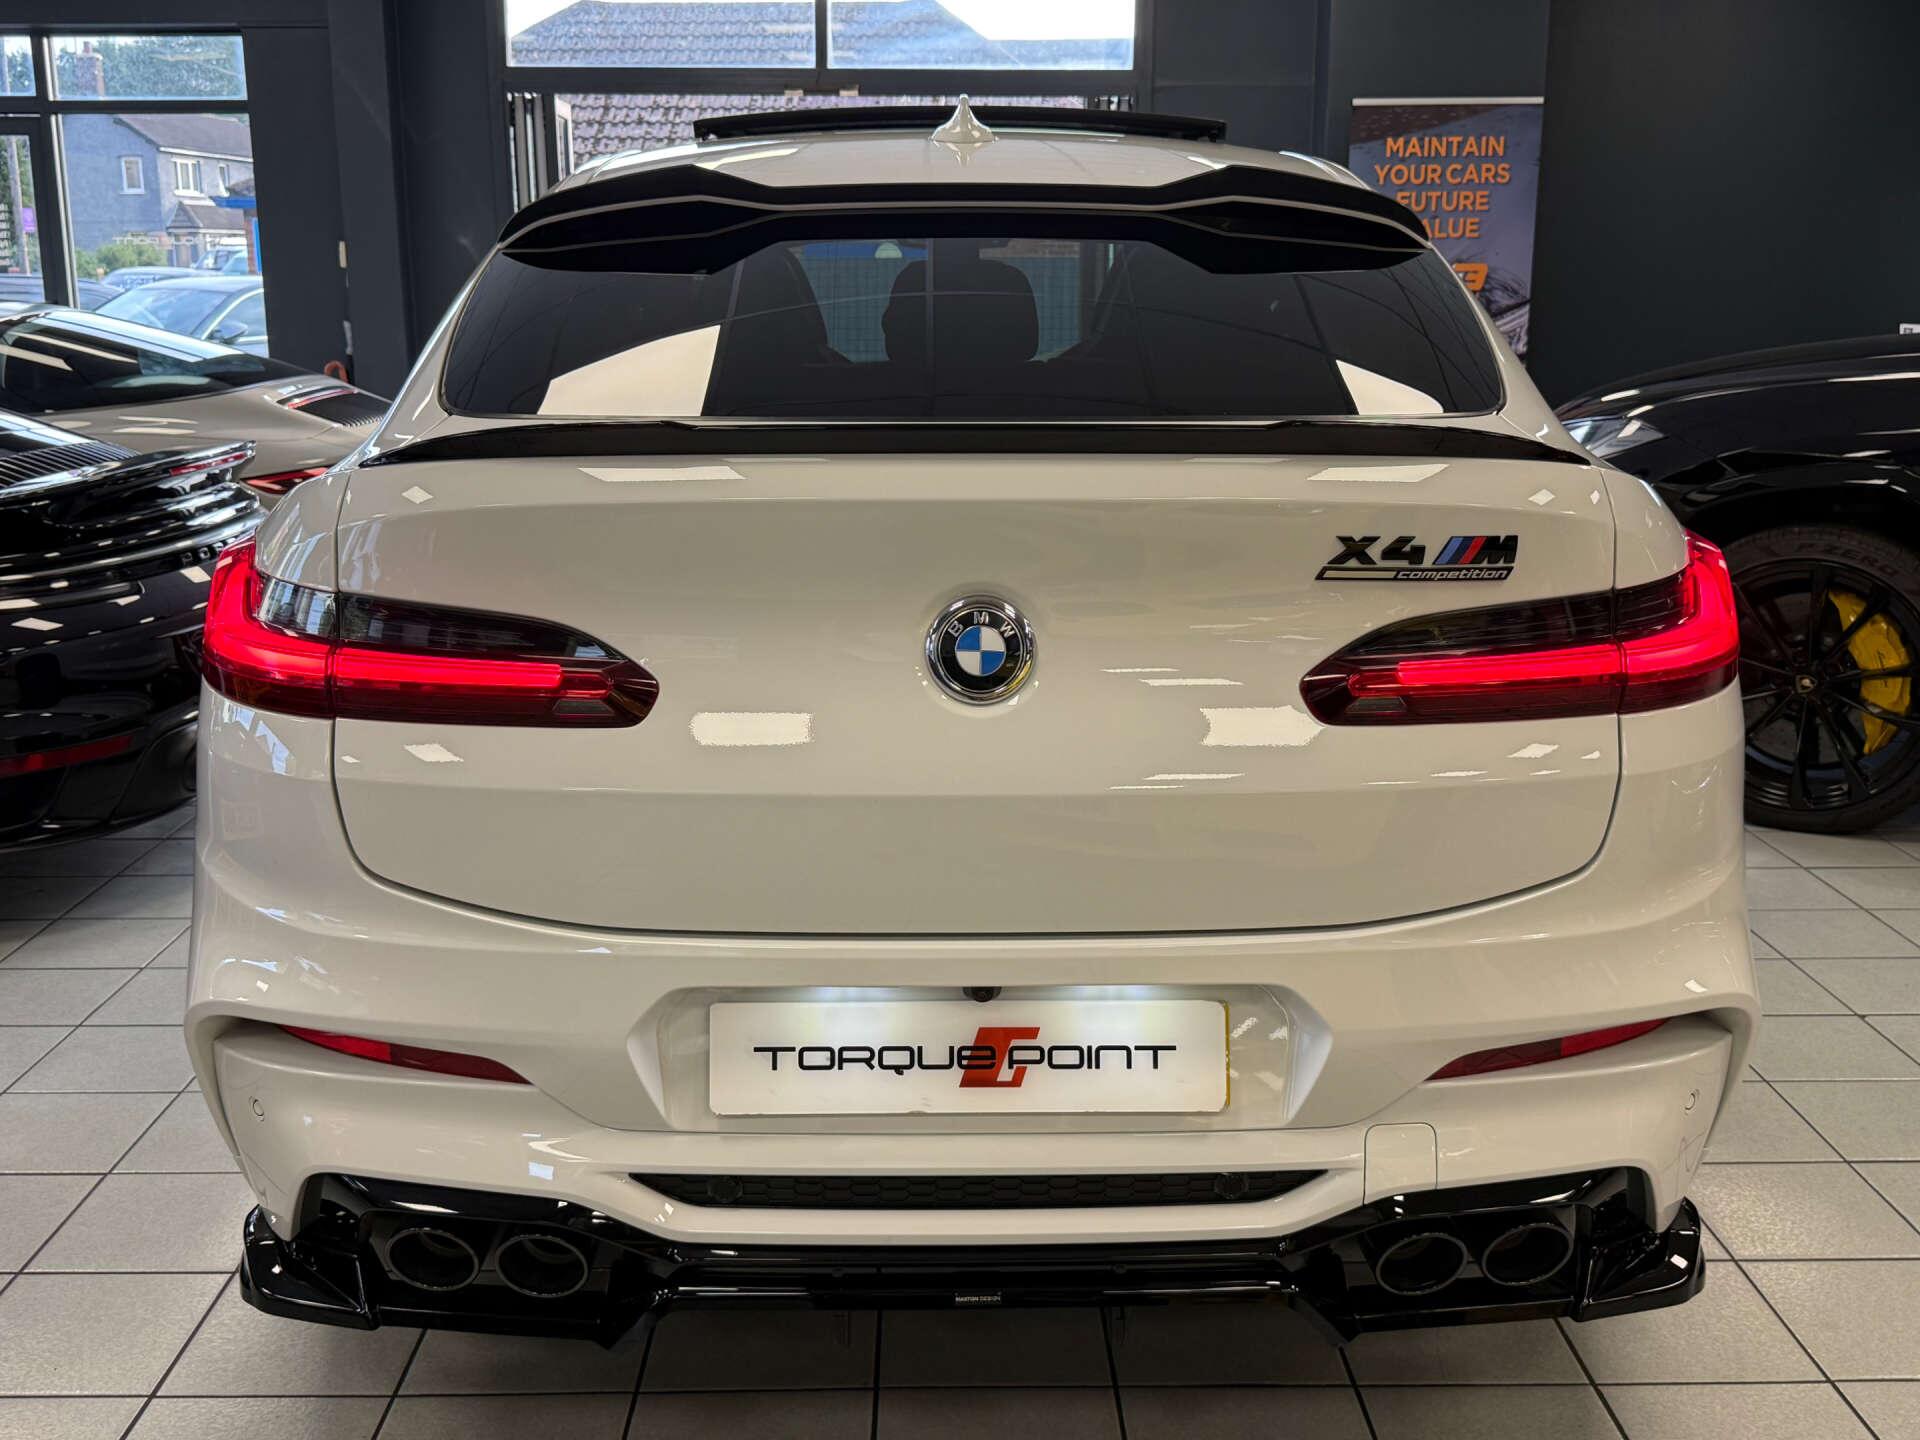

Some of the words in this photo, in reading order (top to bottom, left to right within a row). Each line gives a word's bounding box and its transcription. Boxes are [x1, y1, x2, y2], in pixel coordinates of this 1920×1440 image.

[1385, 136, 1505, 157] MAINTAIN
[1375, 164, 1442, 185] YOUR
[1446, 163, 1510, 184] CARS
[1396, 191, 1489, 212] FUTURE
[1327, 536, 1426, 565] X4
[1397, 569, 1507, 581] competition
[948, 611, 1015, 638] BMW
